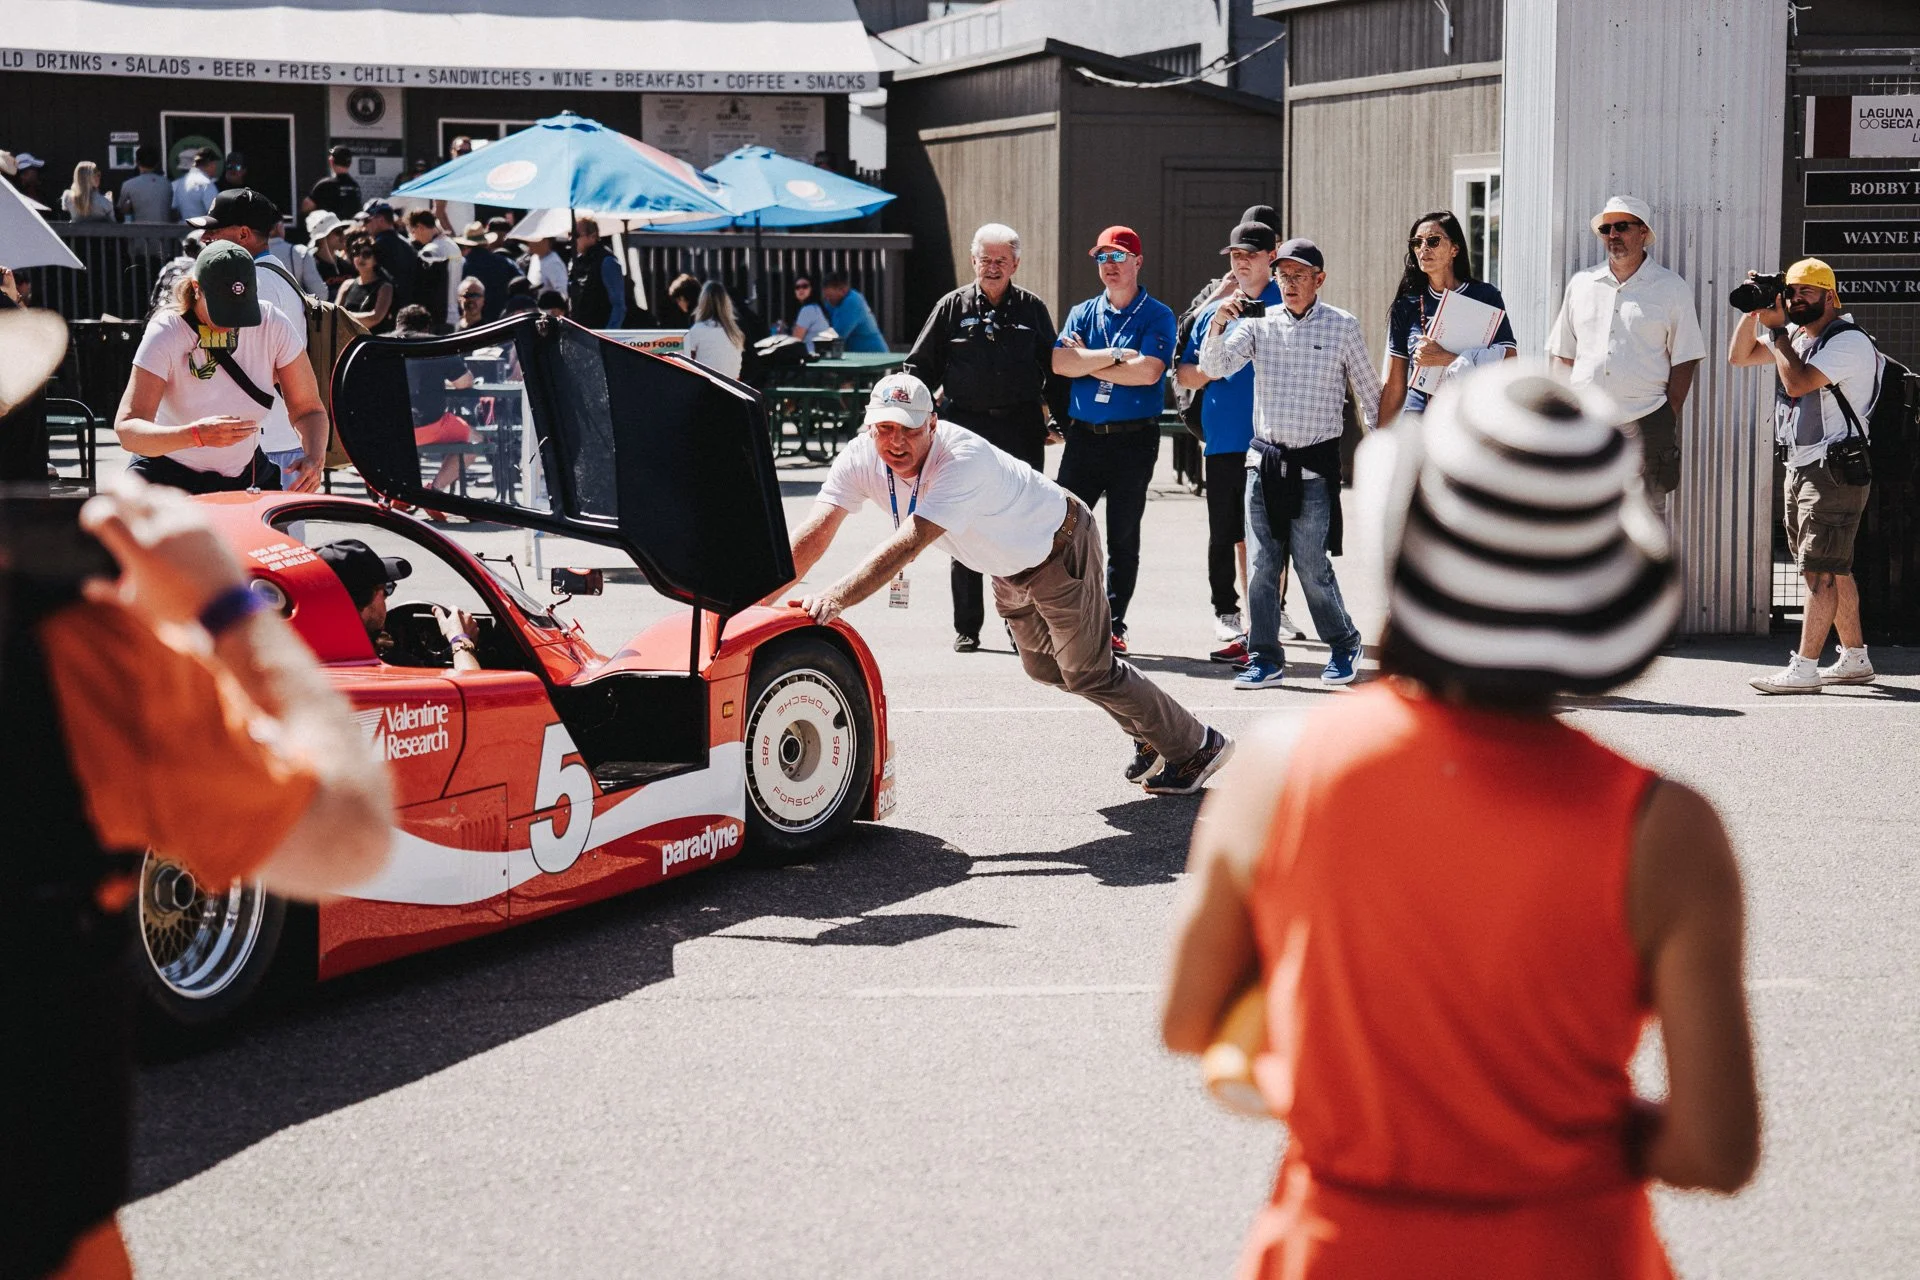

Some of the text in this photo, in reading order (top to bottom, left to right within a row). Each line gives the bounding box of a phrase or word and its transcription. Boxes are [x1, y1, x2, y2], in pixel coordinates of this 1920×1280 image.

[36, 52, 102, 71] DRINKS
[125, 56, 191, 75] SALADS
[213, 61, 256, 77] BEER
[278, 64, 332, 81] FRIES
[354, 66, 405, 83] CHILI
[428, 68, 532, 87] SANDWICHES
[553, 71, 593, 87] WINE
[615, 72, 704, 88] BREAKFAST
[727, 74, 786, 89] COFFEE
[807, 74, 866, 89] SNACKS
[1859, 108, 1914, 118] LAGUNA
[1880, 119, 1914, 129] SECA
[1849, 182, 1910, 195] BOBBY
[1843, 231, 1909, 244] WAYNE
[1837, 280, 1900, 293] KENNY
[385, 700, 449, 733] Valentine
[776, 695, 829, 716] PORSCHE
[387, 724, 449, 760] Research
[762, 735, 771, 766] BBS
[831, 735, 840, 766] BBS
[529, 721, 595, 874] 5
[772, 784, 826, 807] PORSCHE
[662, 823, 739, 875] paradyne
